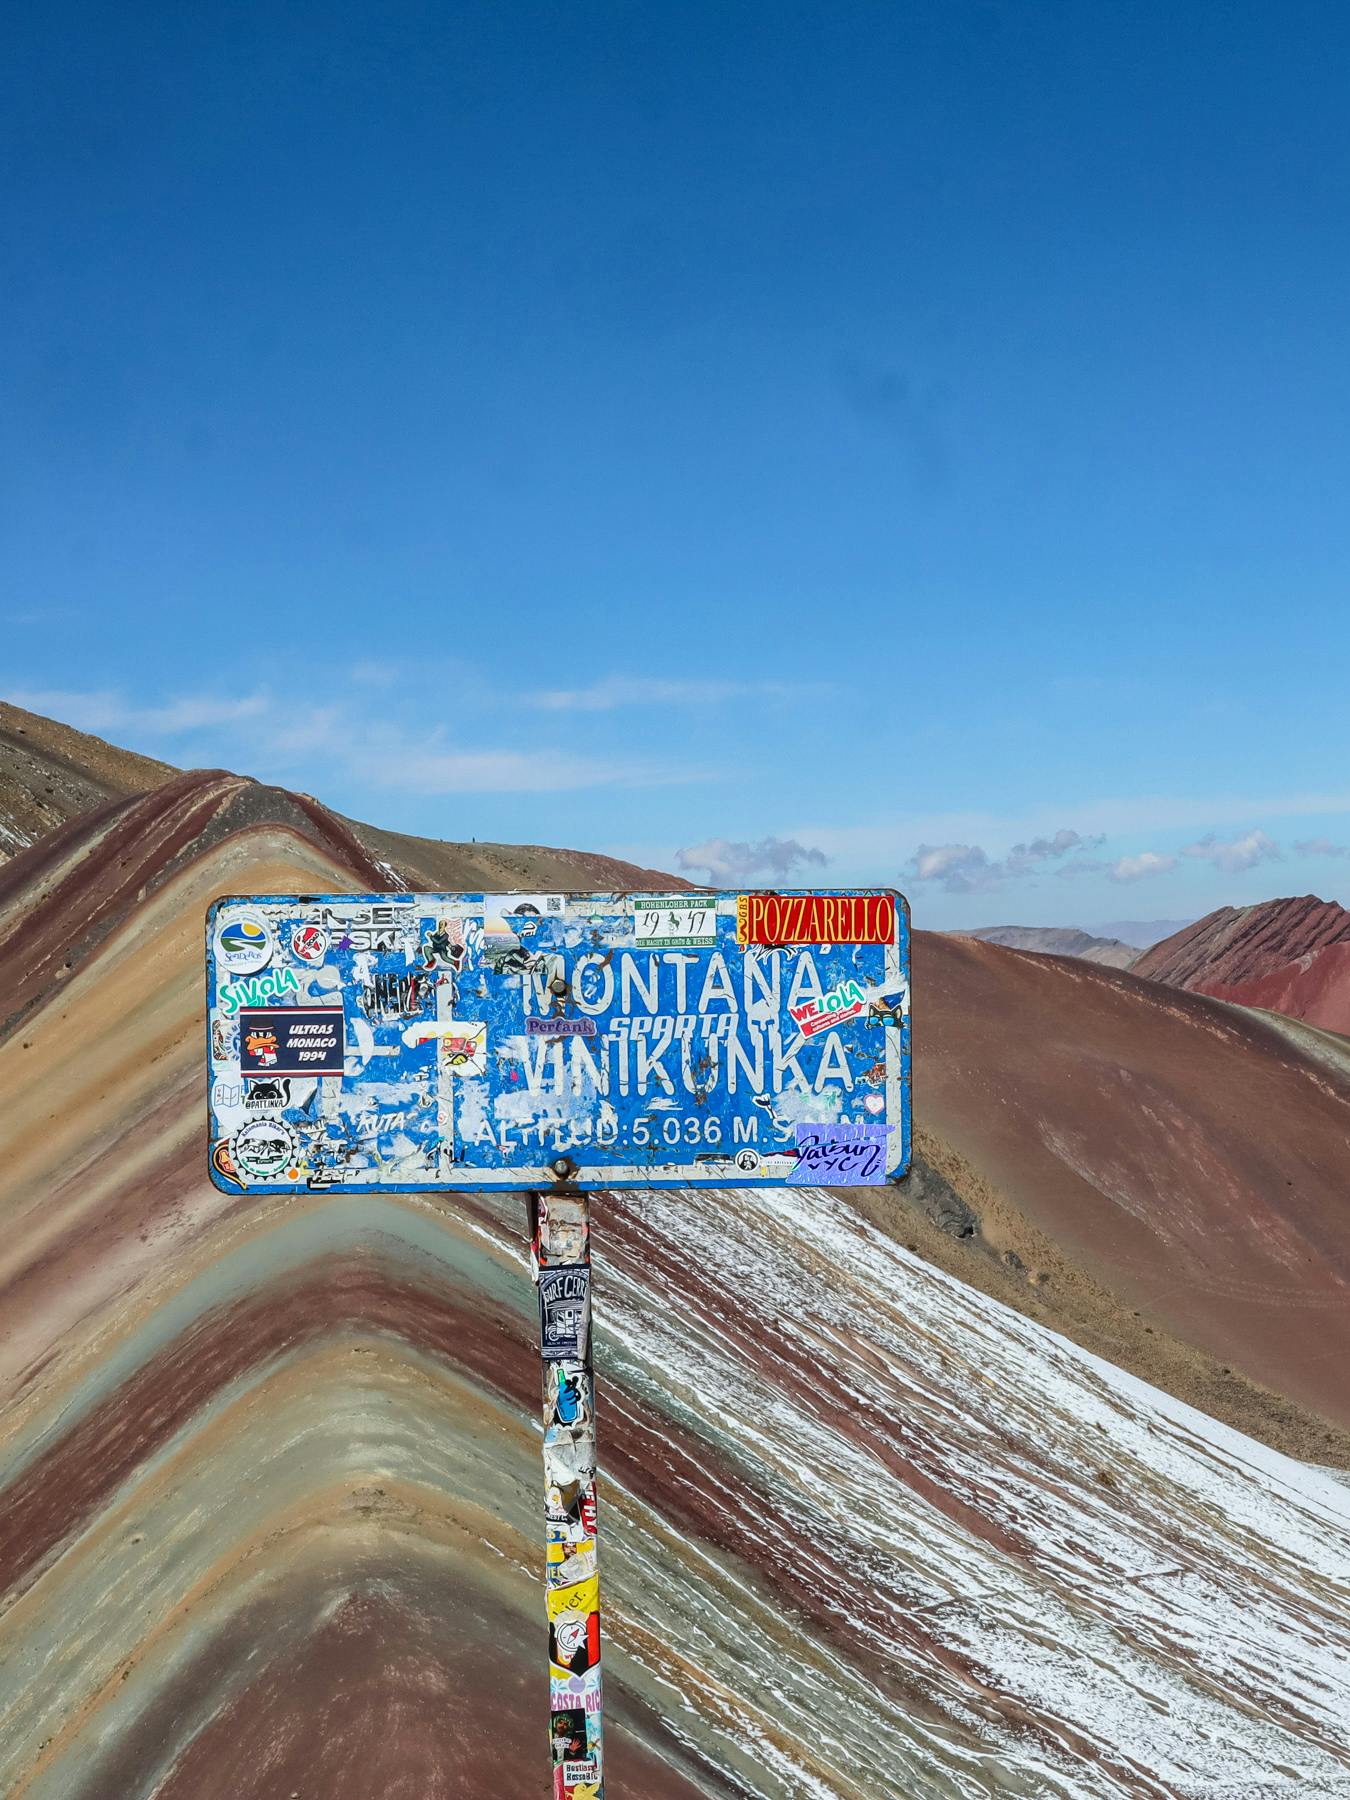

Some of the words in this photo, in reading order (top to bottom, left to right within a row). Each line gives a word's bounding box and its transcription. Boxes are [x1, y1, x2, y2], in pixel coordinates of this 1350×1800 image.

[641, 900, 689, 909] HOHENLOHER
[690, 899, 708, 908] PACK
[642, 911, 660, 936] 19
[752, 897, 893, 942] POZZARELLO
[289, 1024, 335, 1035] ULTRAS
[607, 1013, 740, 1042] SPARTA
[286, 1038, 337, 1048] MONACO
[298, 1051, 327, 1061] 1994
[551, 1692, 582, 1711] COSTA
